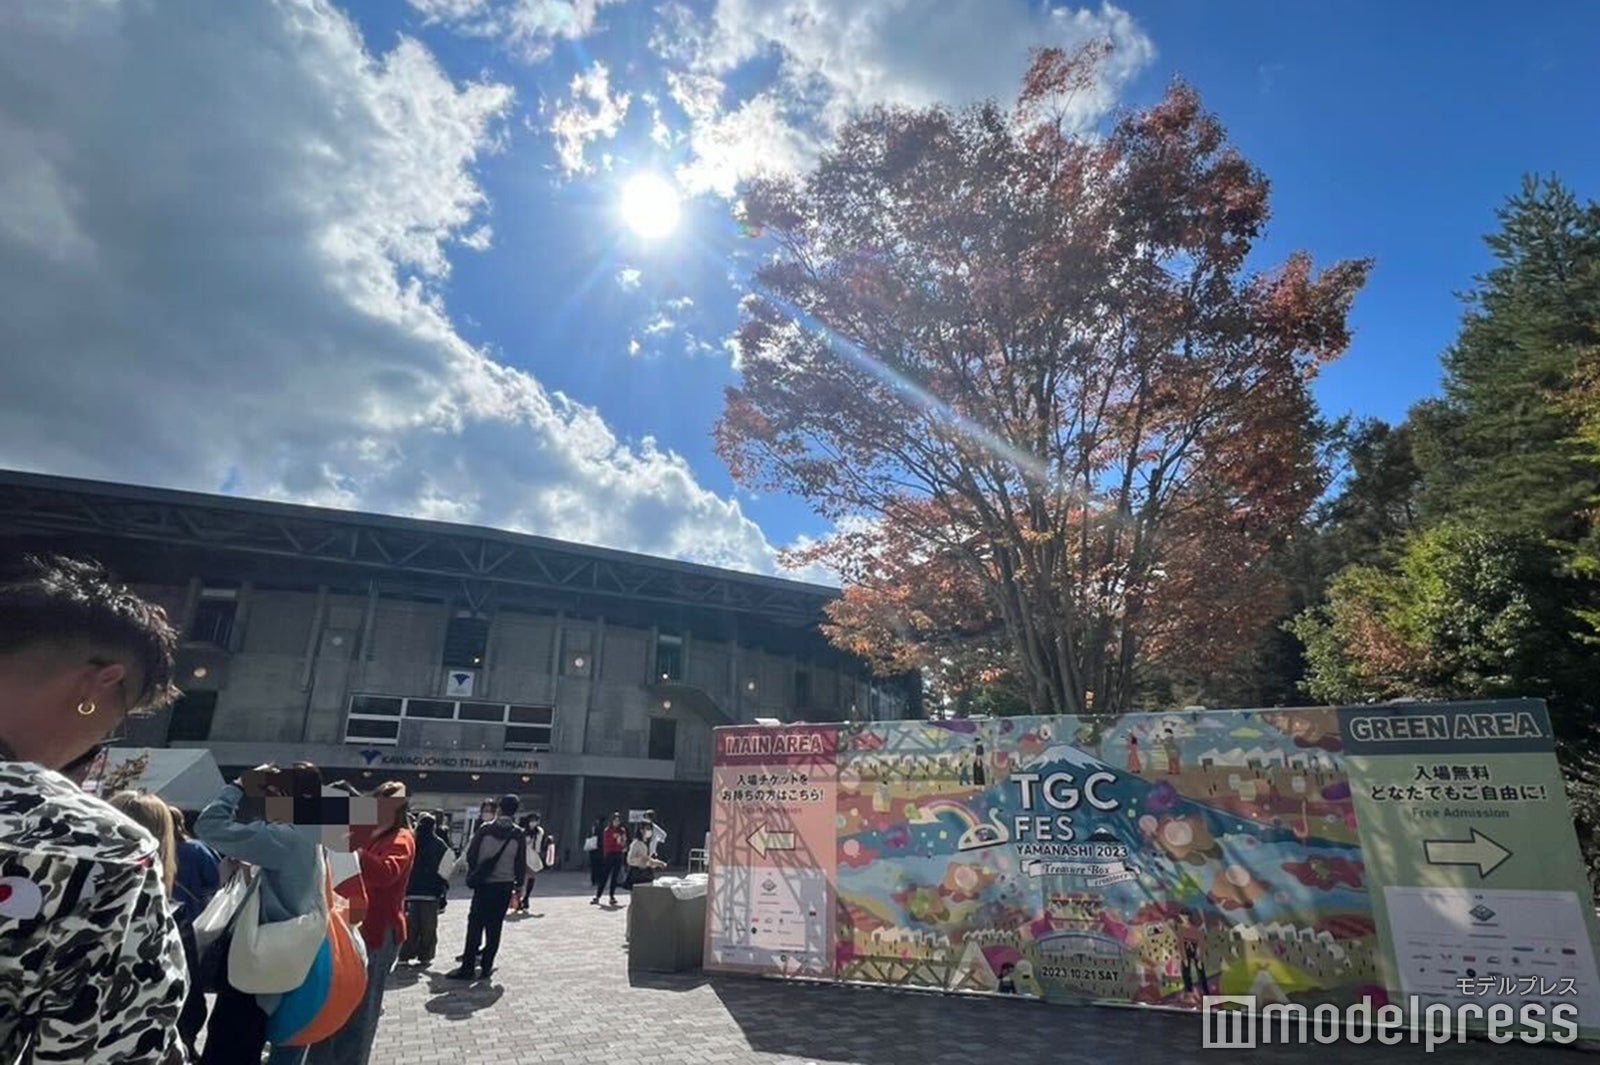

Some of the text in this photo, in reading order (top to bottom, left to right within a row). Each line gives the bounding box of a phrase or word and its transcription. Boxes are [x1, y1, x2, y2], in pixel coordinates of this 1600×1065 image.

[1350, 712, 1542, 742] GREEN AREA
[726, 734, 824, 755] MAIN AREA
[382, 756, 539, 769] KAWAGUCHIKO STELLAR THEATER
[736, 773, 809, 786] 入場チケットを
[1414, 765, 1490, 781] 入場無料
[1010, 772, 1120, 810] TGC
[1412, 807, 1509, 818] Free Admission
[1015, 816, 1075, 841] FES
[1016, 844, 1128, 858] YAMANASHI 2023
[1043, 864, 1110, 874] Treasure Box
[1098, 971, 1119, 981] SAT
